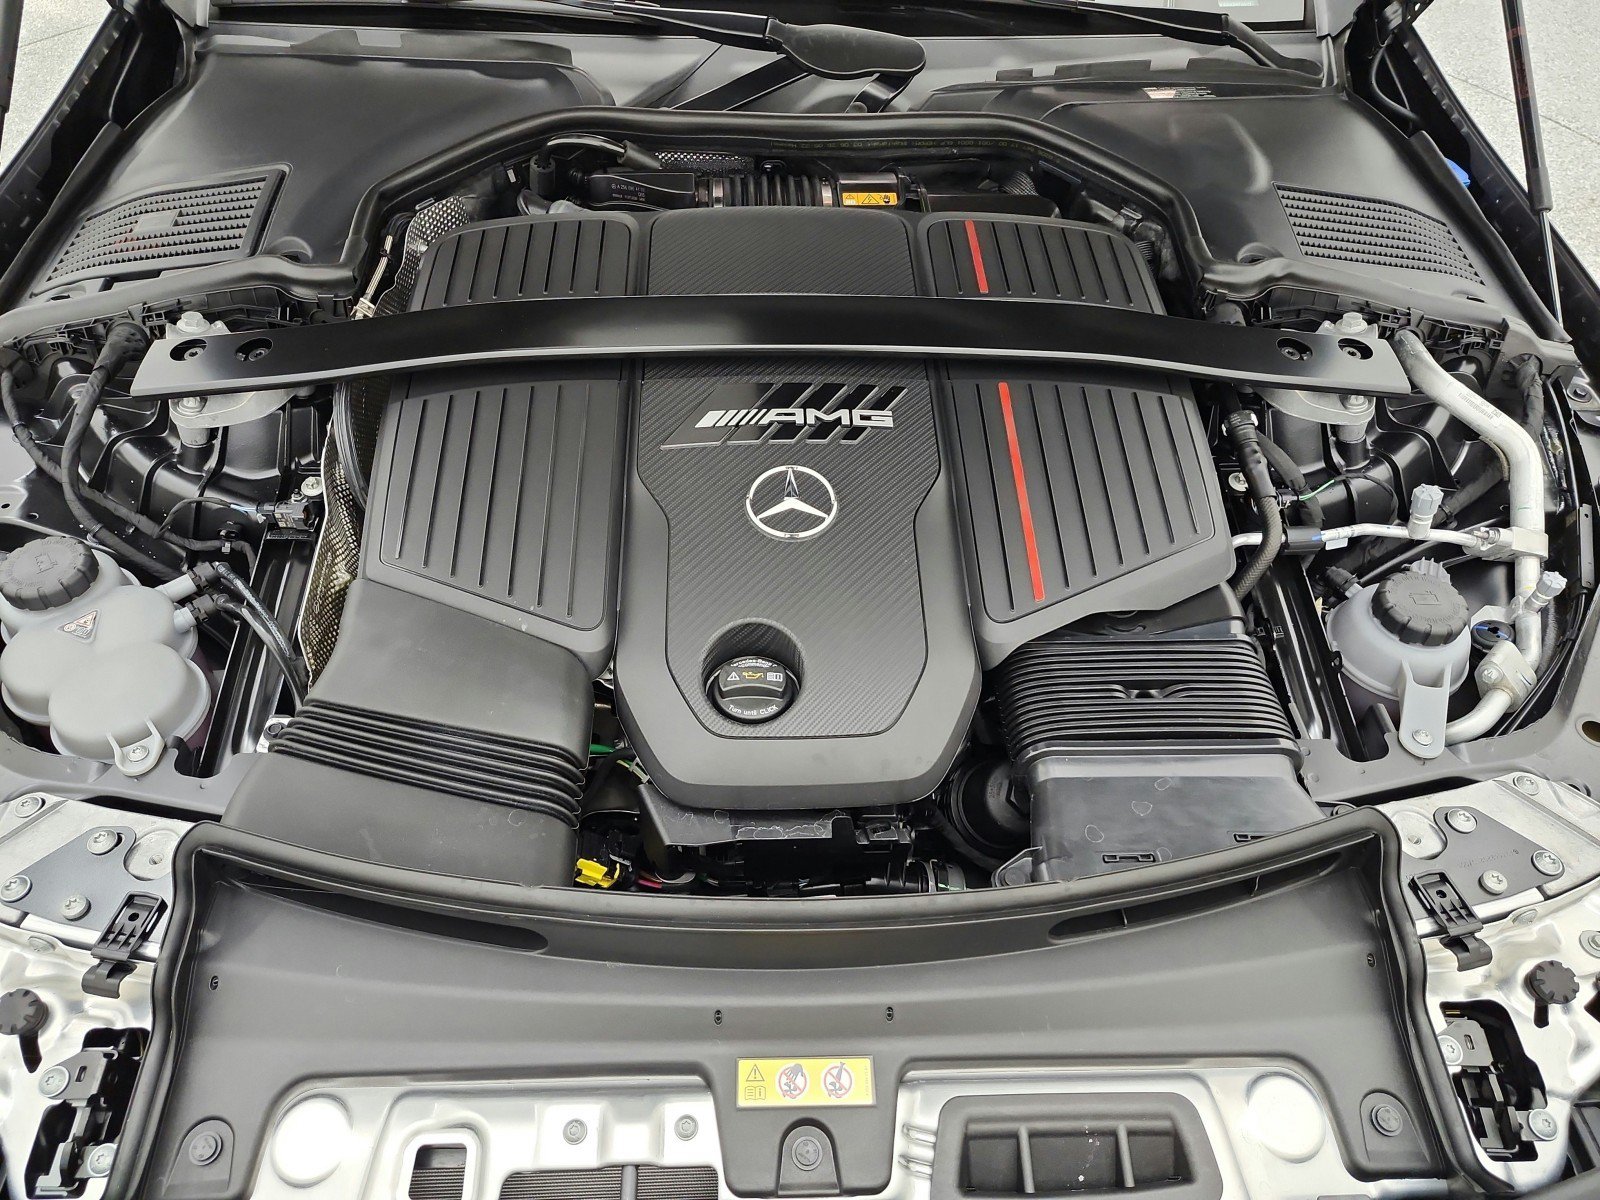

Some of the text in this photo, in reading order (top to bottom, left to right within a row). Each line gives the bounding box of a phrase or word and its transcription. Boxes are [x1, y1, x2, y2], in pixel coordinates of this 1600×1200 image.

[758, 408, 894, 428] AMG
[728, 704, 742, 714] Turn
[759, 704, 779, 715] CLICK
